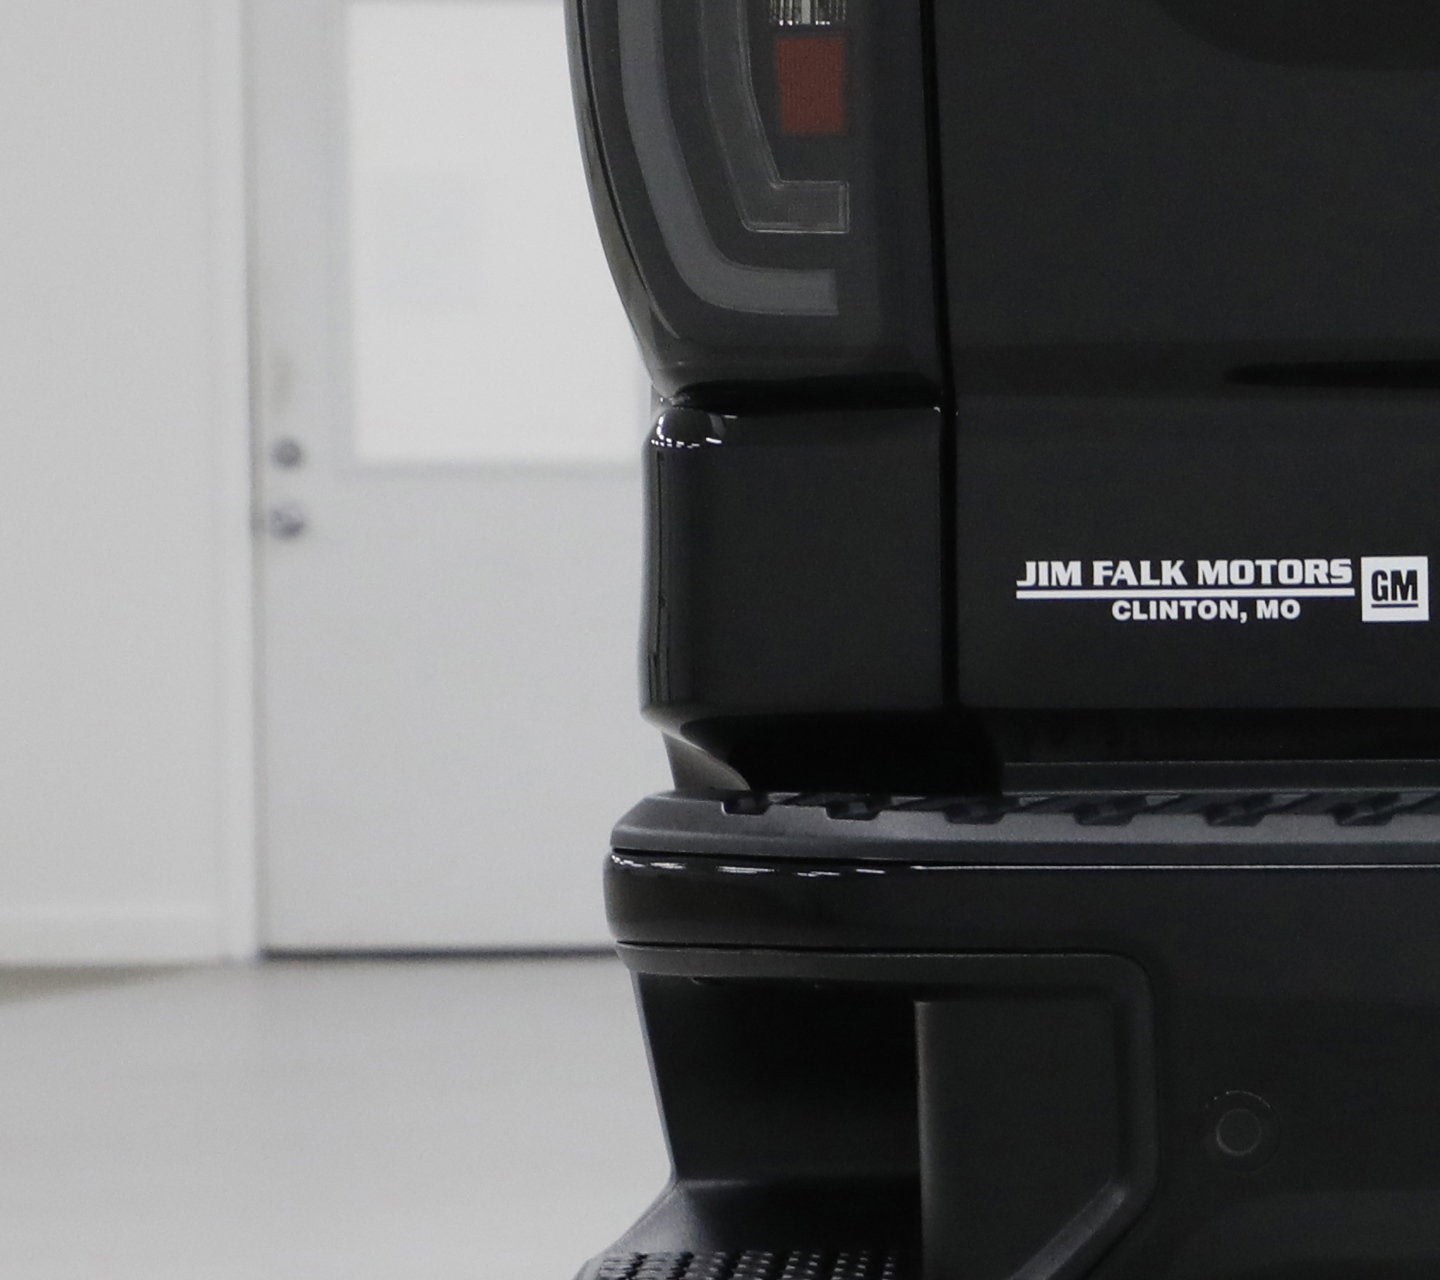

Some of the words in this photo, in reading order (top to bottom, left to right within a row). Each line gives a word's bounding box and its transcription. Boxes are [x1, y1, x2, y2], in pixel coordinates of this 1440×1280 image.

[1016, 560, 1083, 588] JIM
[1093, 560, 1189, 587] FALK
[1197, 558, 1354, 586] MOTORS
[1371, 569, 1419, 602] GM
[1111, 600, 1249, 624] CLINTON,
[1255, 598, 1302, 621] MO
